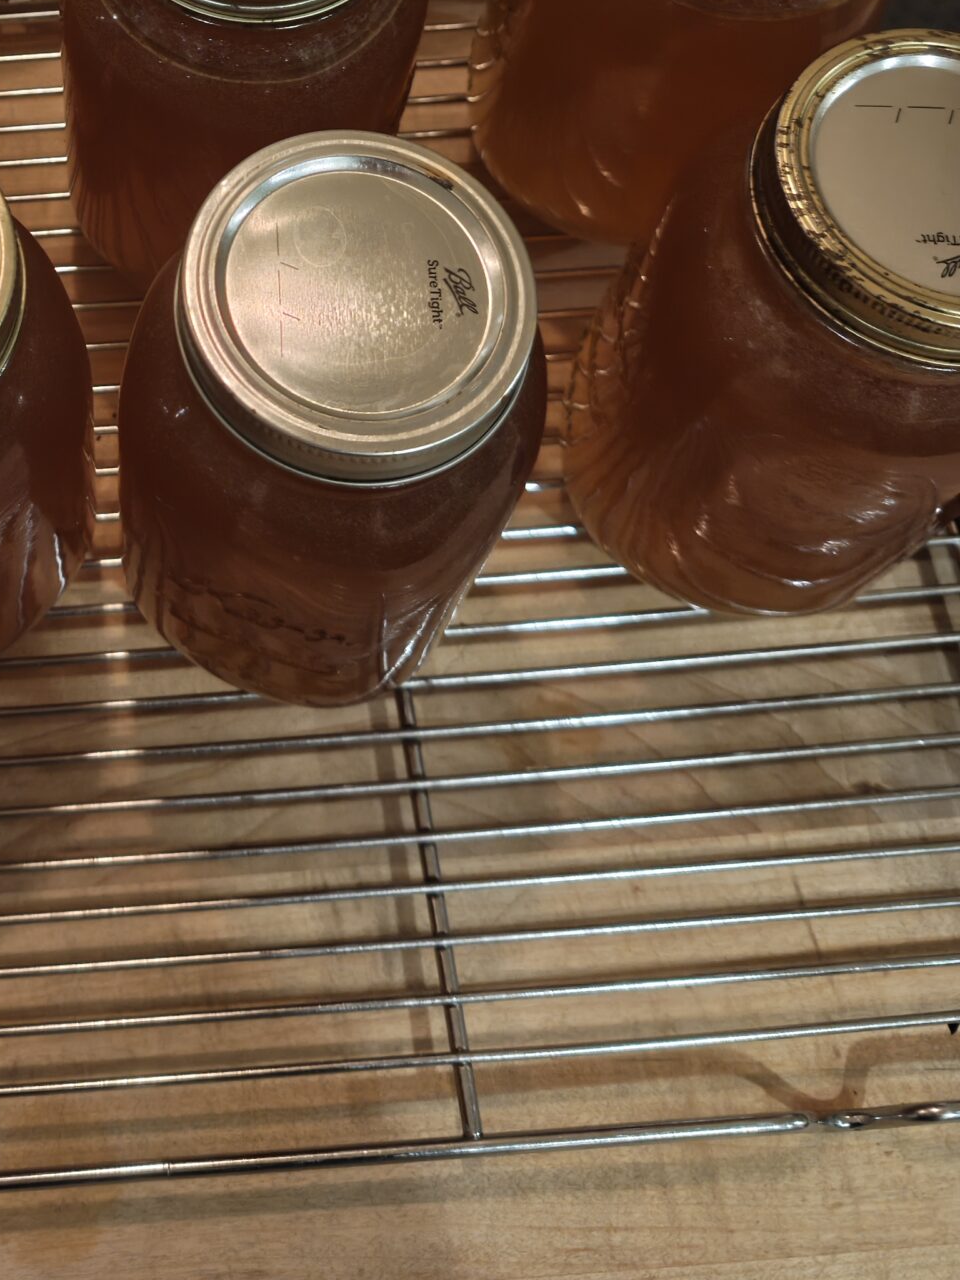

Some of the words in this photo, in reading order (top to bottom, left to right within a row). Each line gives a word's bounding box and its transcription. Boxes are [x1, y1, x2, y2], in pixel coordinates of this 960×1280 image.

[915, 231, 960, 246] Tight
[427, 259, 444, 330] SureTight
[442, 266, 479, 317] Ball
